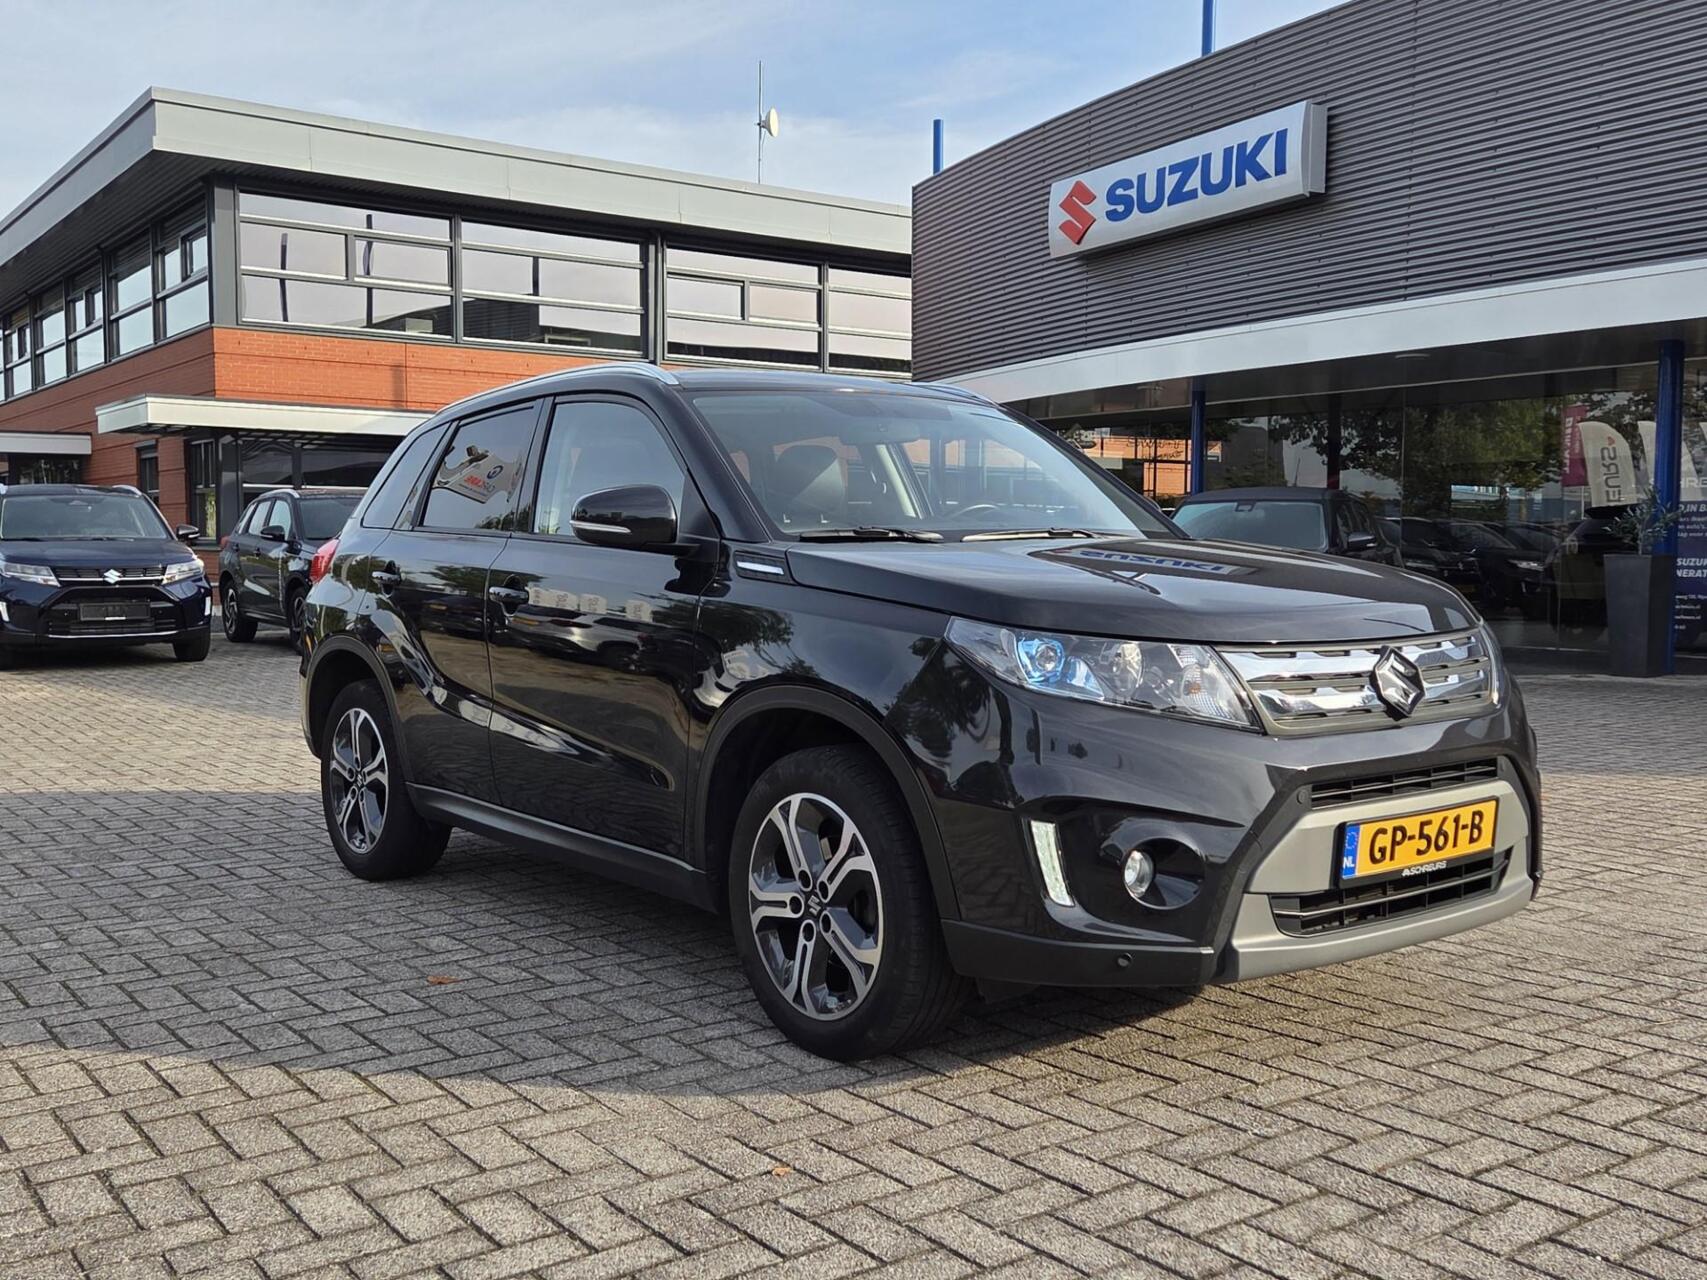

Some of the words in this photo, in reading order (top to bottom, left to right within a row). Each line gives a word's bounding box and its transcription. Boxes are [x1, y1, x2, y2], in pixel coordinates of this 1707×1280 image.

[1105, 128, 1289, 222] SUZUKI
[1343, 856, 1355, 868] NL
[1369, 810, 1484, 865] GP-561-B
